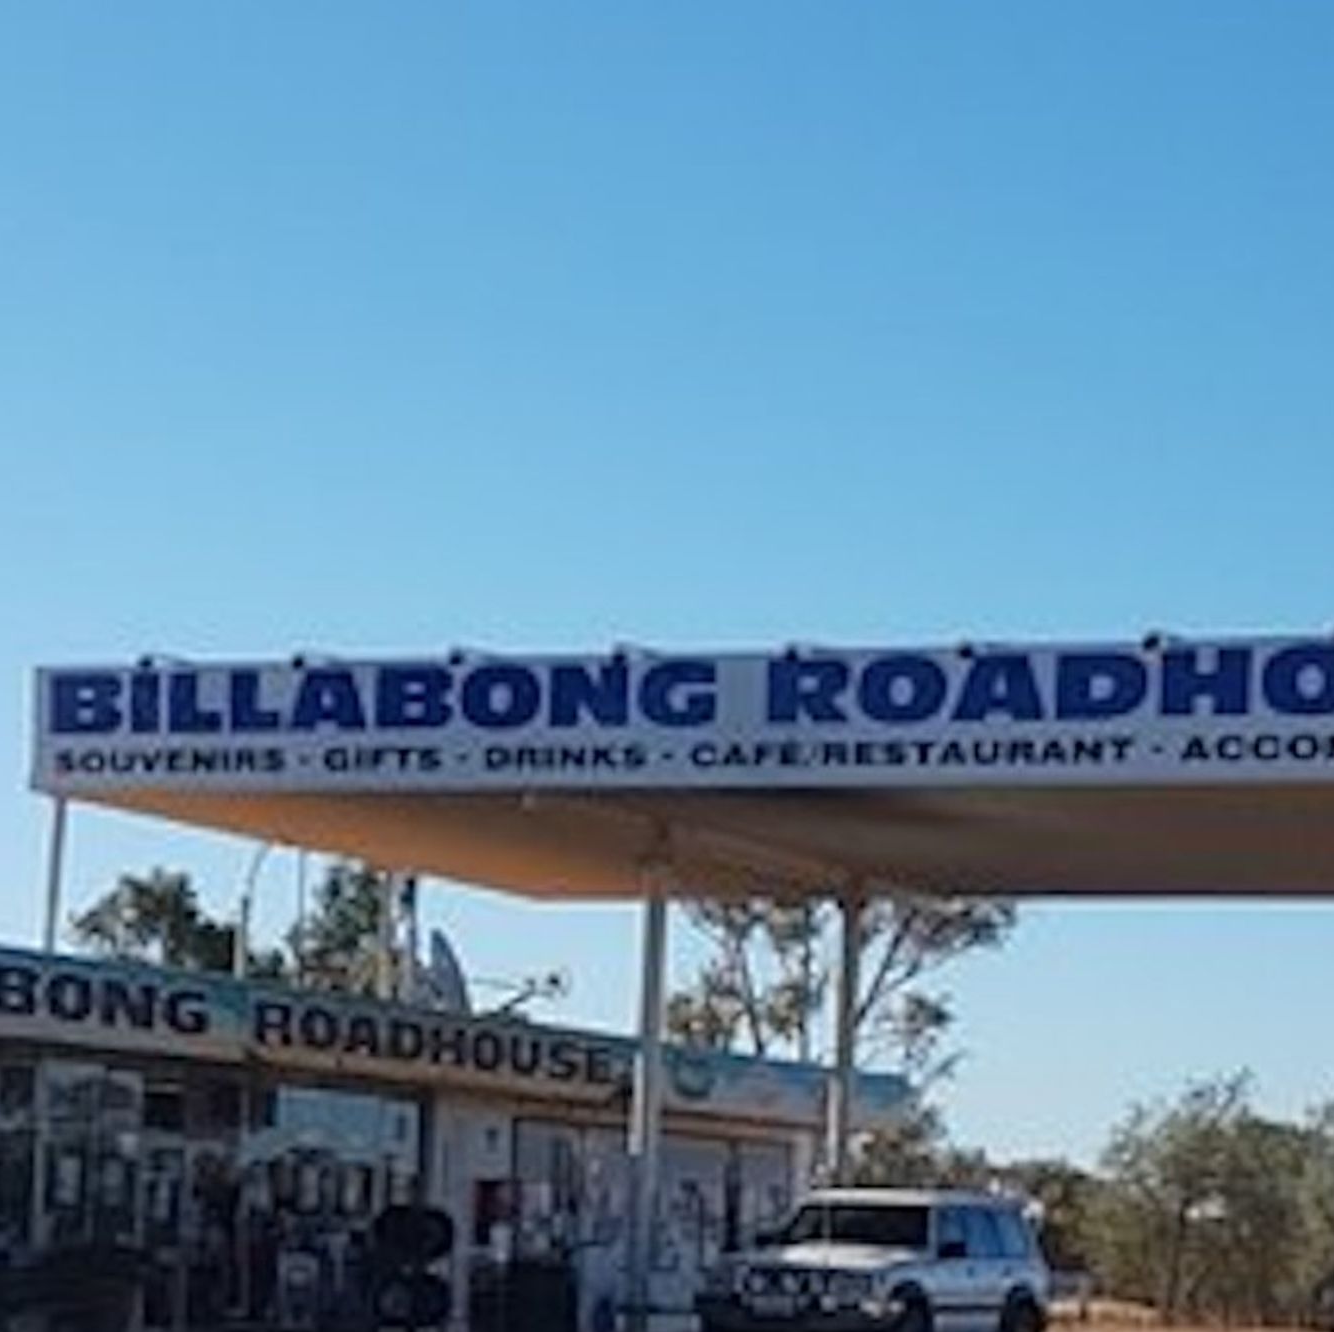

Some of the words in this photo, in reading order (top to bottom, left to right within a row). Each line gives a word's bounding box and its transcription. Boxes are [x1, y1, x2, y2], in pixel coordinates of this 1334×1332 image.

[49, 659, 716, 734] BILLABONG
[54, 745, 286, 774] SOUVENIRS
[322, 745, 443, 773] GIFTS
[484, 744, 647, 771] DRINKS
[252, 1002, 612, 1084] ROADHOUSE
